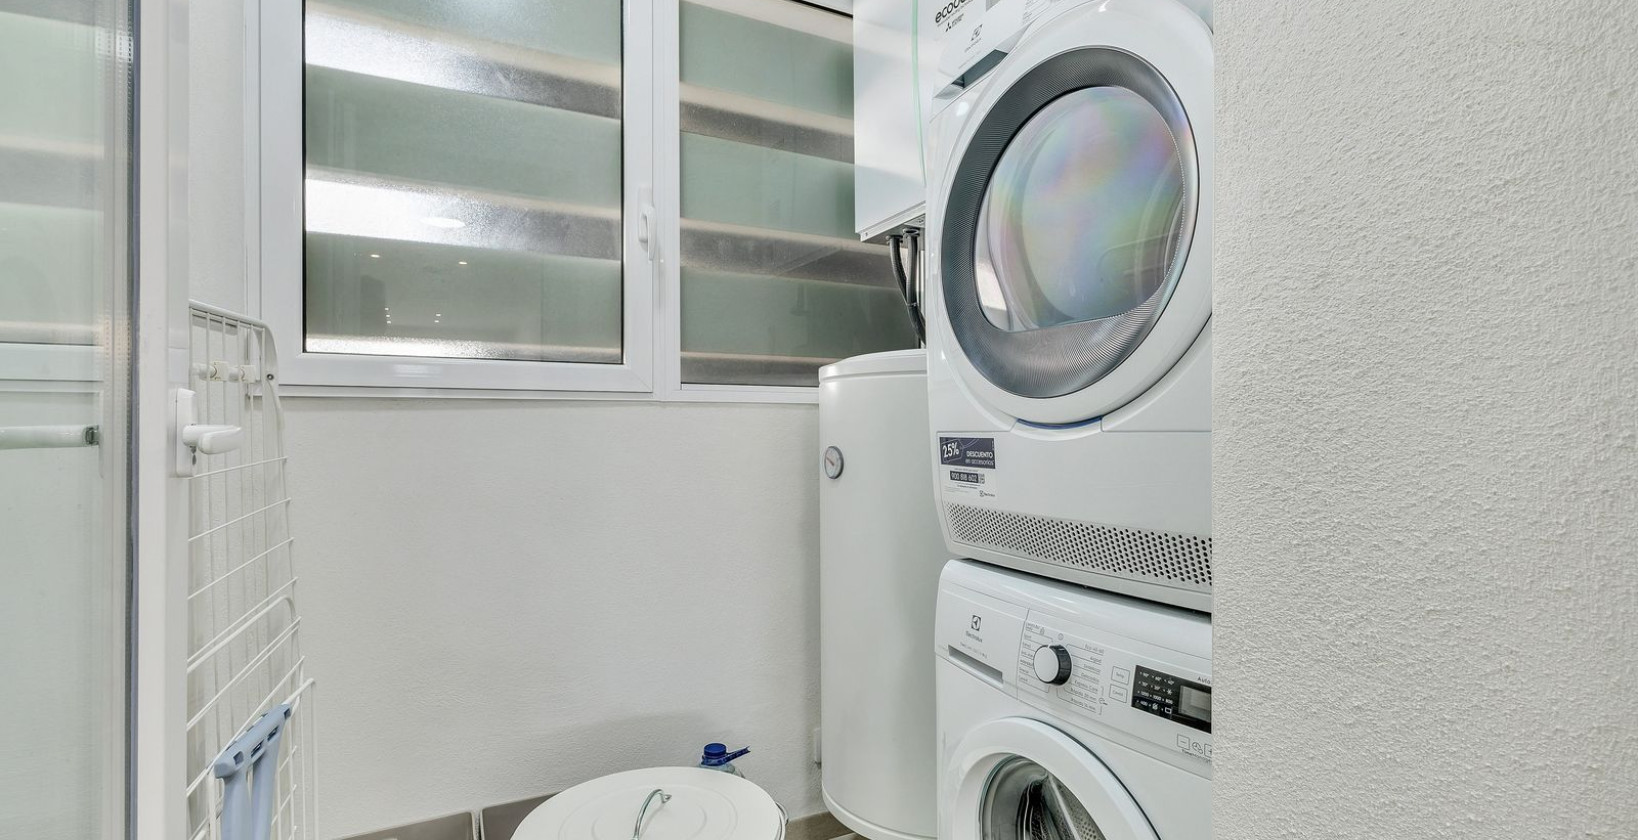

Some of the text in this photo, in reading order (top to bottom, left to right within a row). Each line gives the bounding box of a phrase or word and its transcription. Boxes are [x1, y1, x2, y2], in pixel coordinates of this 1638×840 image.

[943, 442, 960, 458] 25%
[966, 451, 994, 459] DESCUENTO
[951, 472, 960, 480] 900
